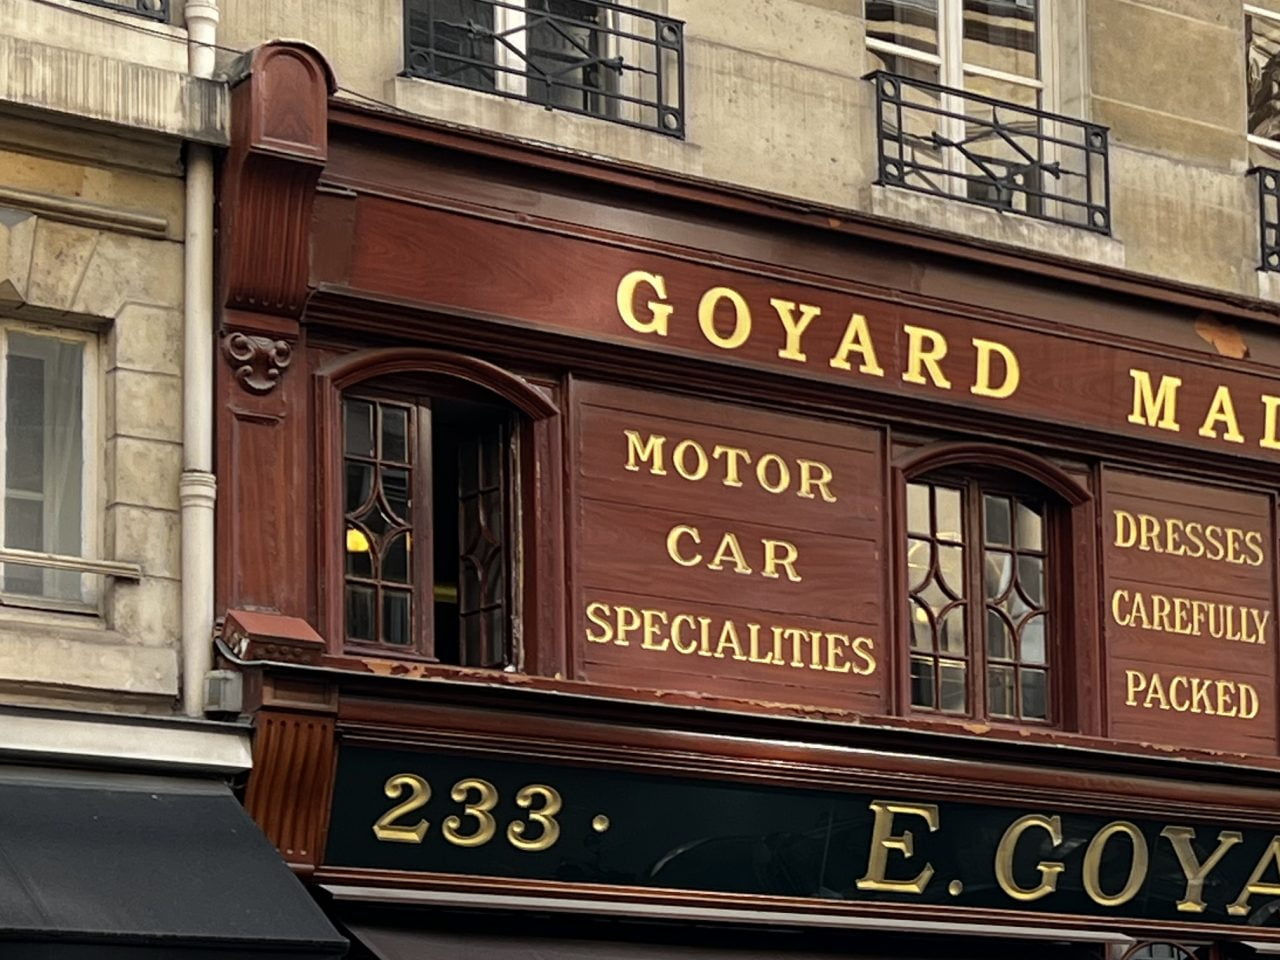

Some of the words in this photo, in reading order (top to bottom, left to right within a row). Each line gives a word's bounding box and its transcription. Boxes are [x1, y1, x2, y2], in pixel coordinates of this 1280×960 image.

[616, 270, 1021, 399] GOYARD
[623, 429, 838, 503] MOTOR
[666, 524, 803, 582] CAR
[1113, 510, 1265, 567] DRESSES
[584, 602, 877, 676] SPECIALITIES
[1111, 589, 1270, 644] CAREFULLY
[1125, 670, 1260, 721] PACKED
[372, 773, 564, 852] 233
[855, 799, 965, 896] E.
